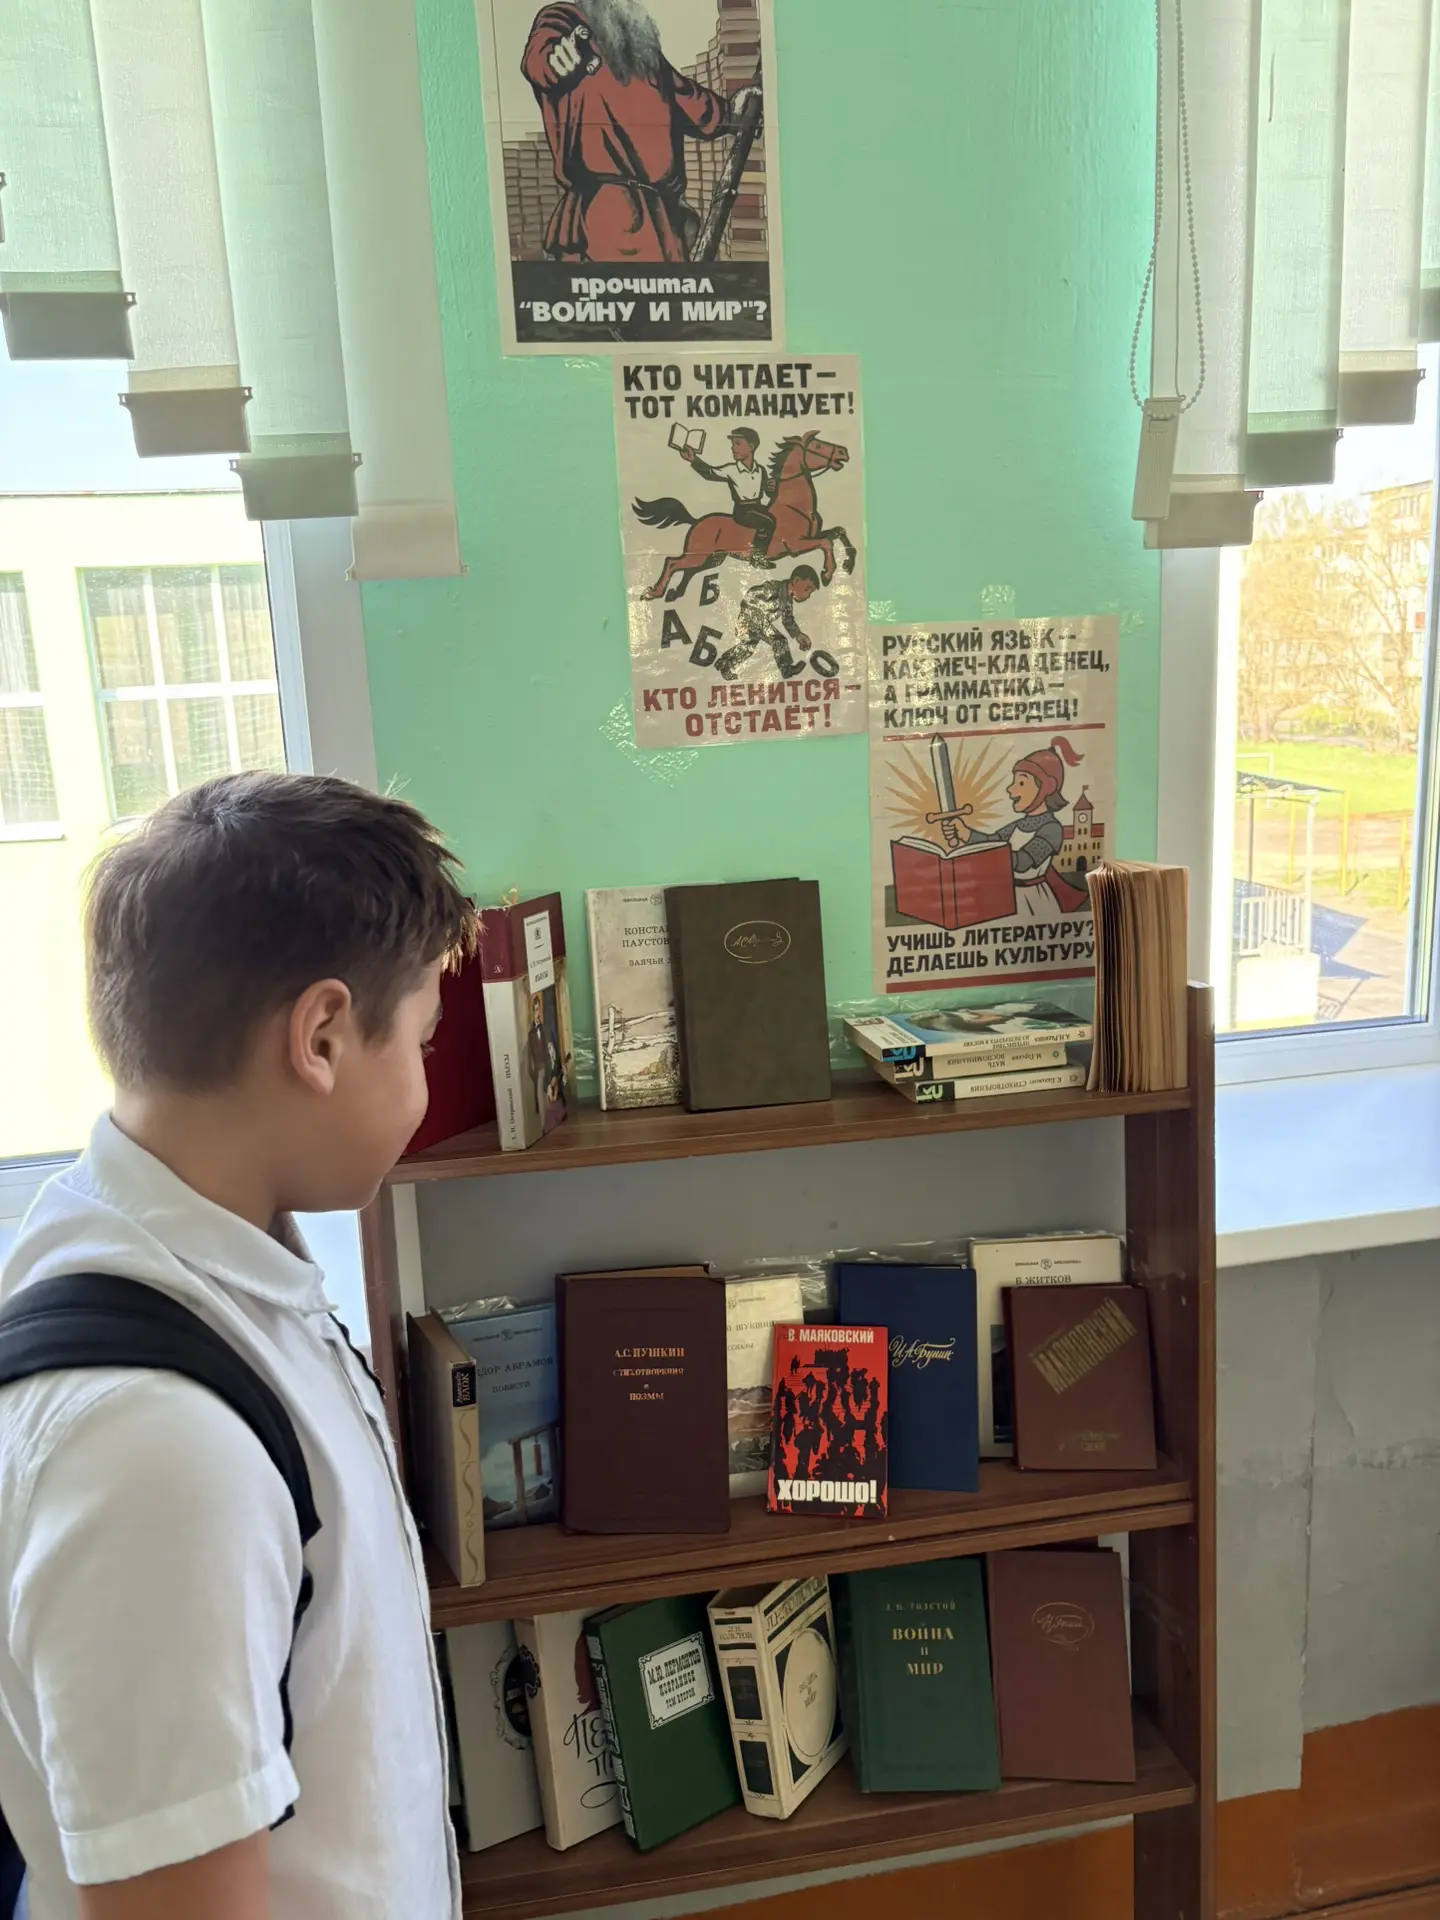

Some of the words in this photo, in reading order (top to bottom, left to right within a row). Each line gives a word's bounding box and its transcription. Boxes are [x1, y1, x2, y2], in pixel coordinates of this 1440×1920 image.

[571, 277, 714, 299] прочитал
[649, 302, 670, 322] И
[622, 364, 682, 391] КТО
[624, 396, 675, 419] ТОТ
[687, 391, 855, 419] КОМАНДУЕТ!
[660, 609, 692, 648] А
[882, 626, 983, 656] РУССКИЙ
[934, 650, 1110, 677] МЕЧ-КЛАДЕНЕЦ,
[643, 686, 697, 712] КТО
[883, 684, 898, 704] А
[685, 703, 832, 737] ОТСТАЁТ!
[883, 704, 949, 729] КЛЮЧ
[955, 704, 981, 724] ОТ
[988, 698, 1079, 723] СЕРДЕЦ!
[887, 931, 956, 952] УЧИШЬ
[962, 920, 1095, 947] ЛИТЕРАТУРУ?
[886, 950, 988, 977] ДЕЛАЕШЬ
[1025, 1274, 1072, 1285] ЖИТКОВ
[799, 1327, 874, 1344] МАЯКОВСКИЙ
[777, 1479, 877, 1504] ХОРОШО!
[891, 1622, 955, 1641] ВОЙНА
[907, 1662, 944, 1676] МИР
